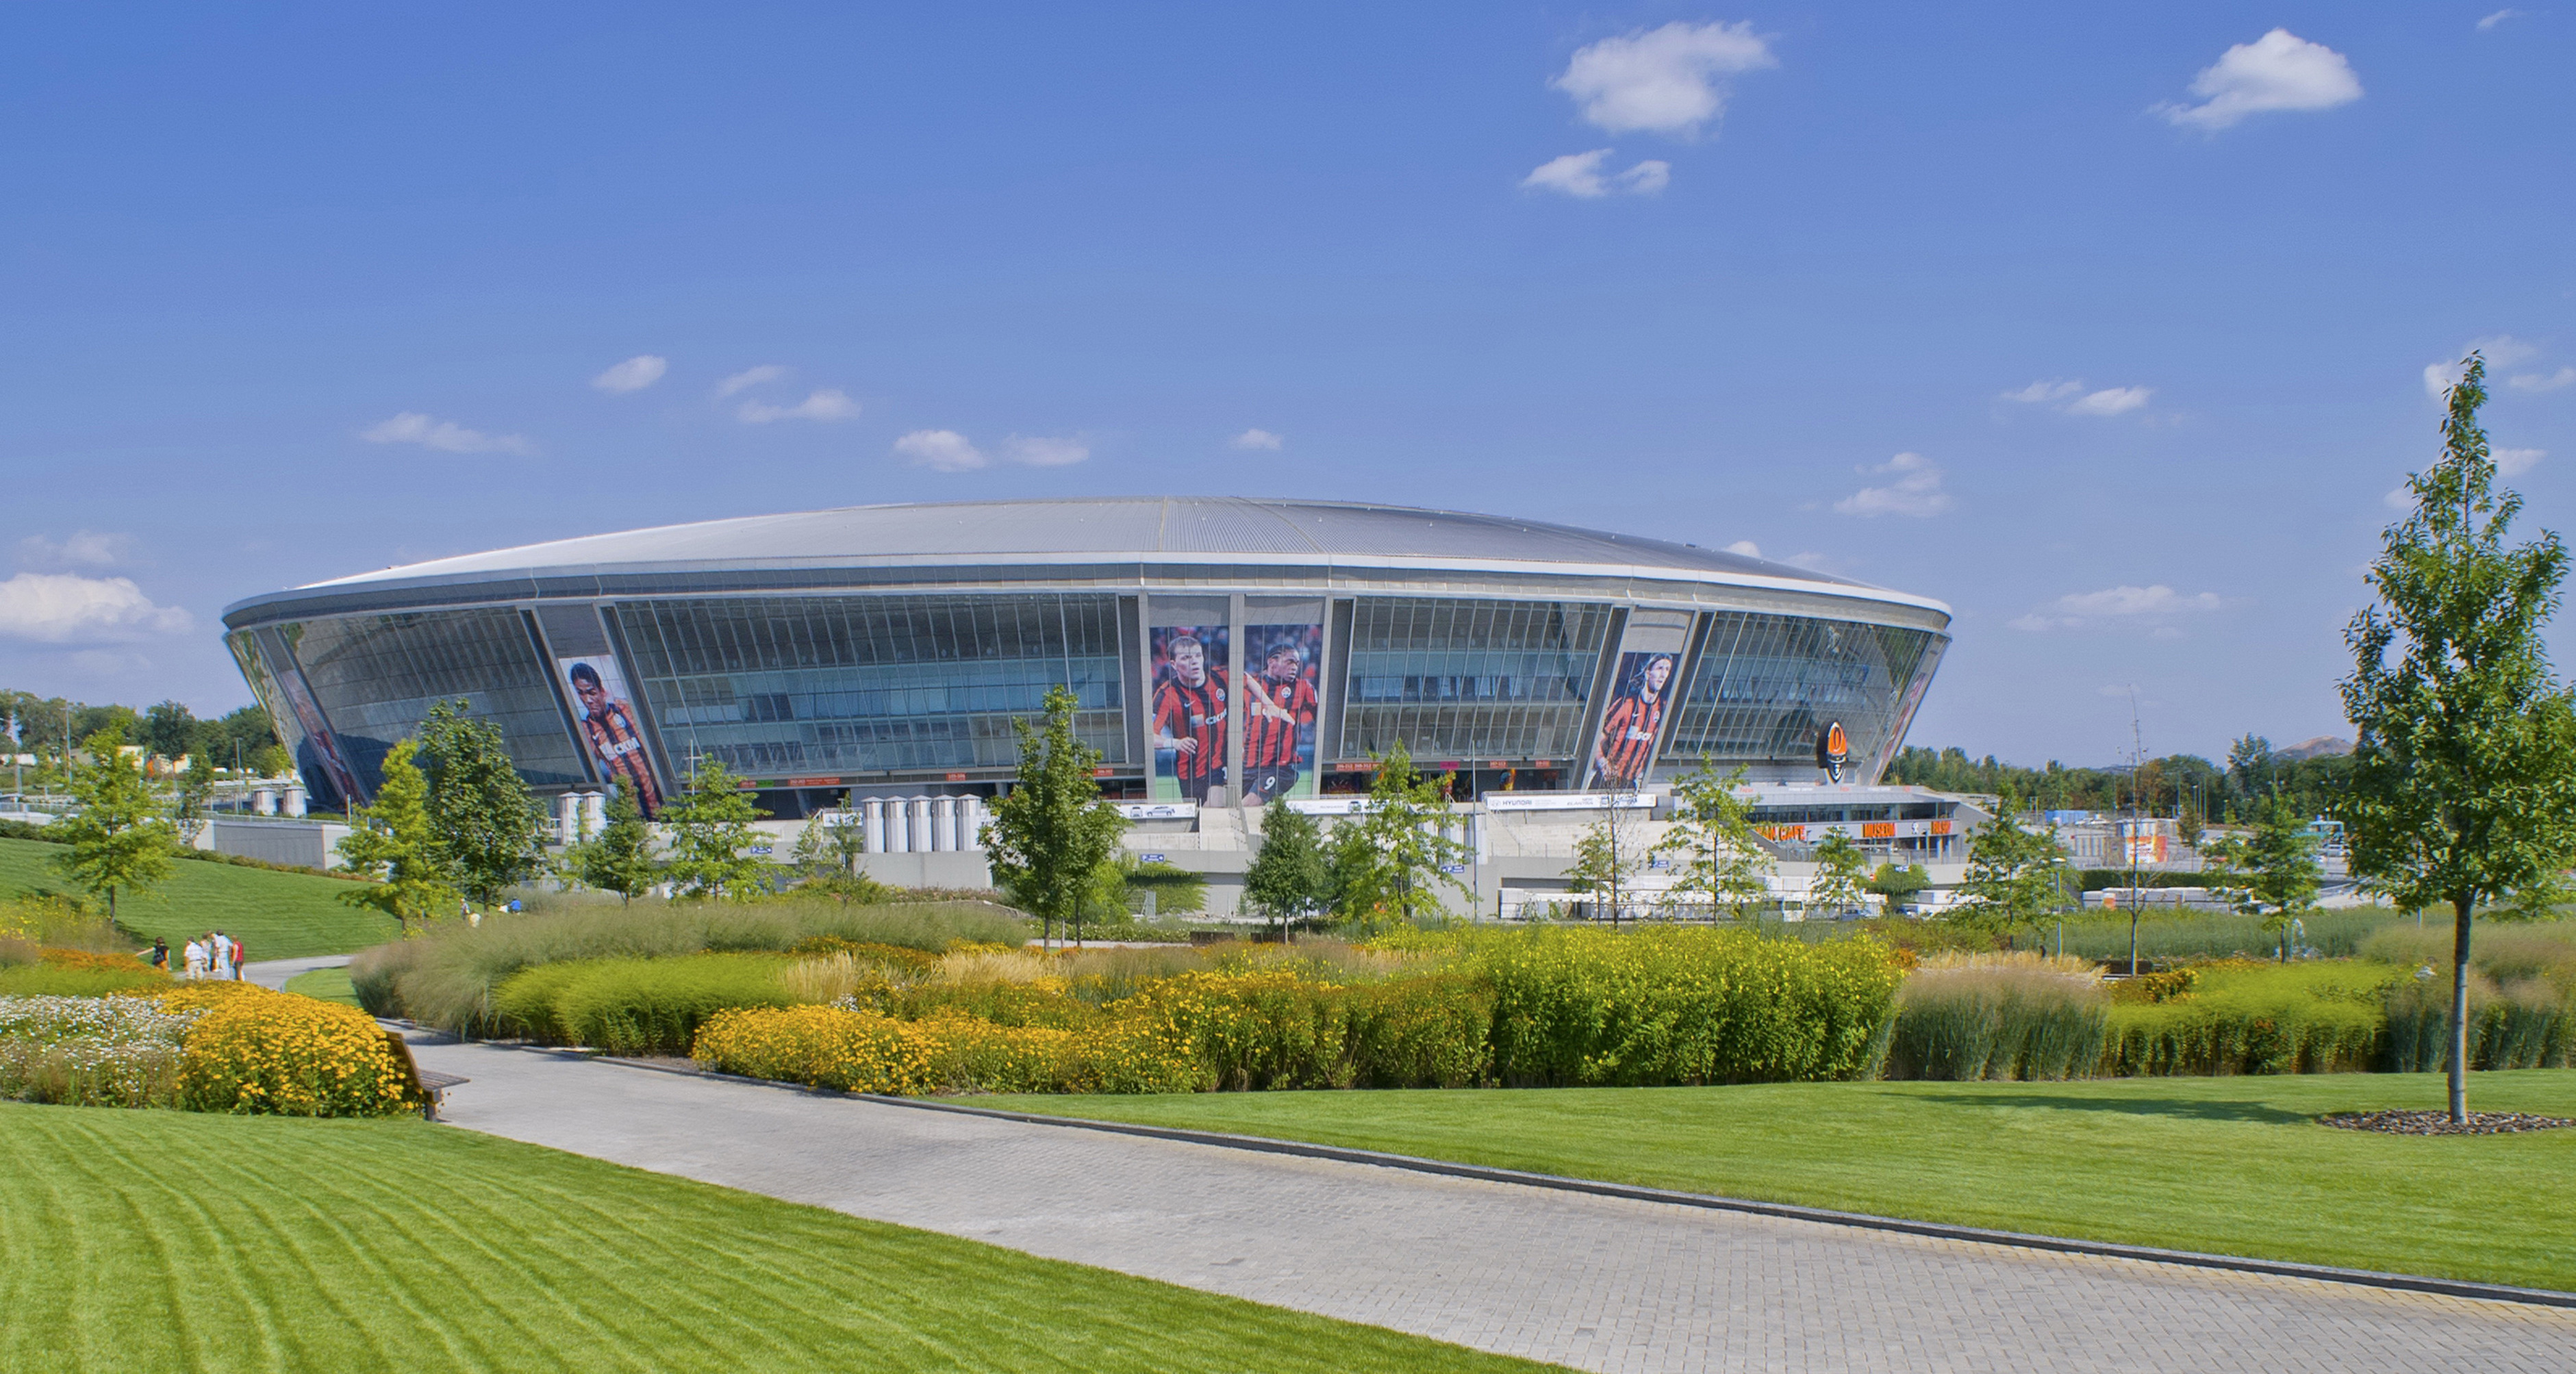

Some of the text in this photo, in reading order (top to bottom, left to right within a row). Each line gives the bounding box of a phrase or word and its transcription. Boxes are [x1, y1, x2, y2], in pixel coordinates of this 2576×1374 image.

[1264, 776, 1276, 790] 9
[1779, 825, 1806, 841] CAFE
[1863, 823, 1895, 838] MUSEUM
